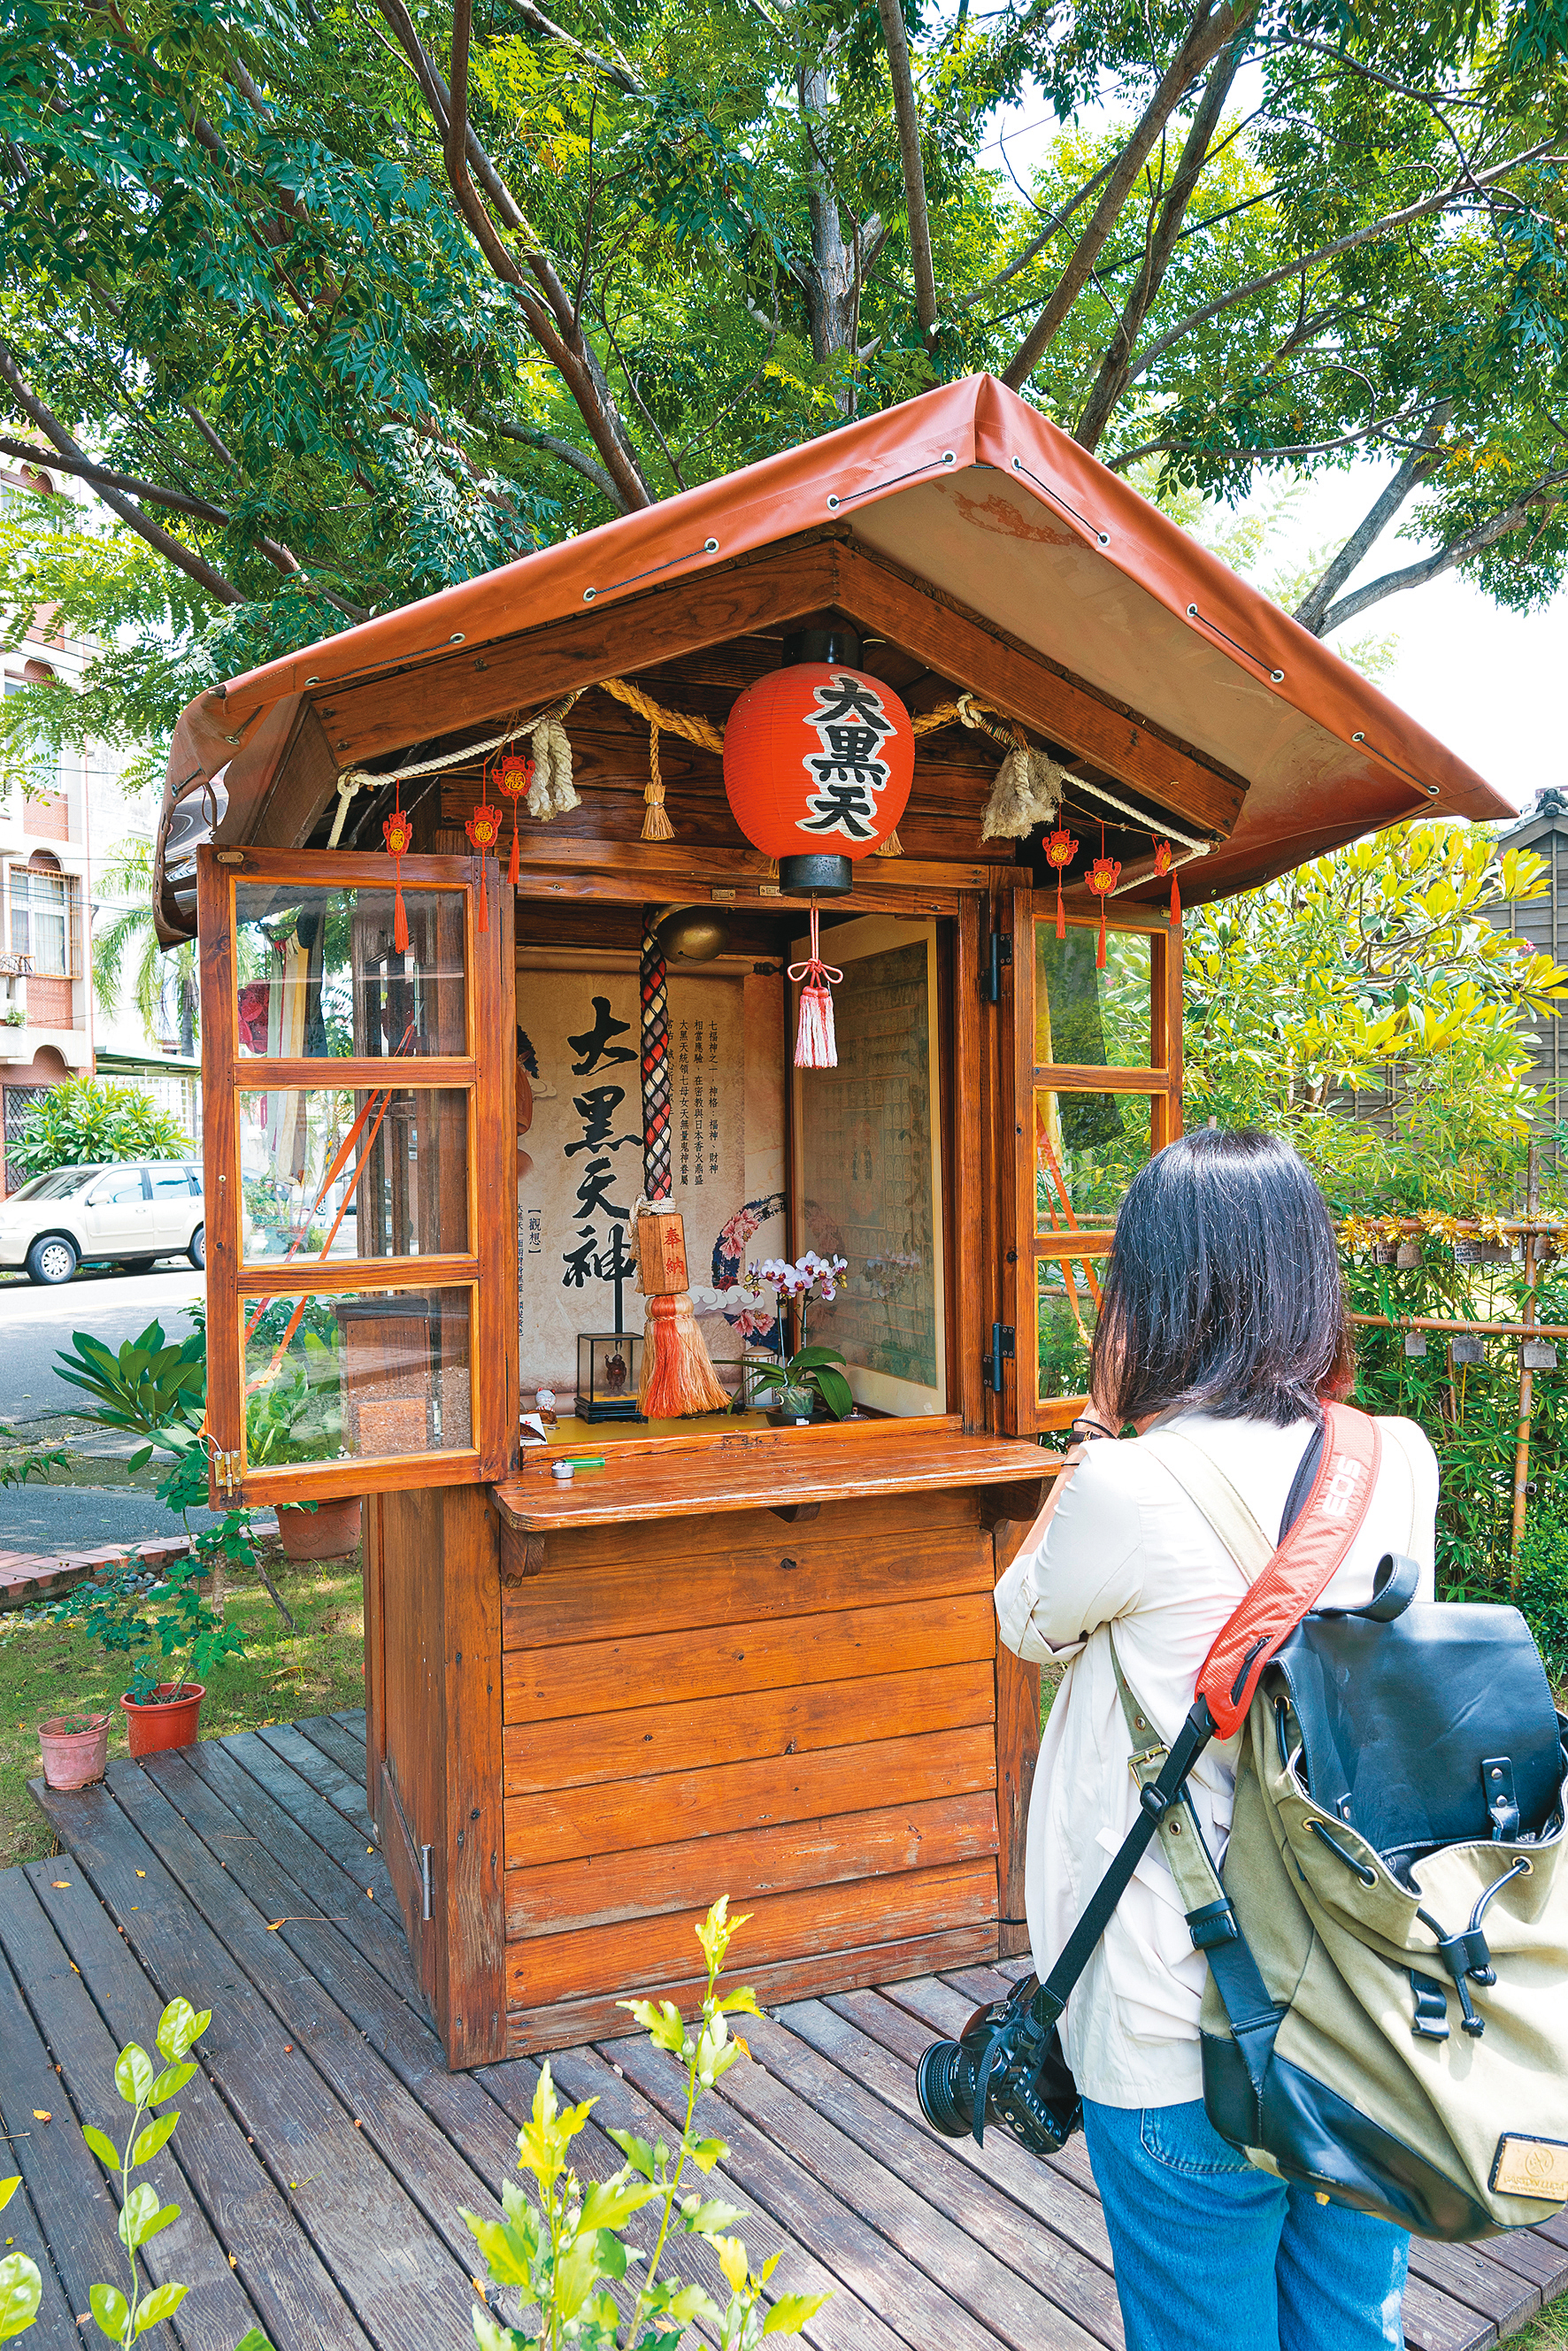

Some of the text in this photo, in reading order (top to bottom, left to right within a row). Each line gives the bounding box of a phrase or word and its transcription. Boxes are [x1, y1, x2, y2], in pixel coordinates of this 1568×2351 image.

[802, 675, 893, 837] 大黑天
[562, 995, 643, 1334] 大黑天神
[663, 1226, 685, 1276] 奉納
[1322, 1454, 1361, 1517] EOS
